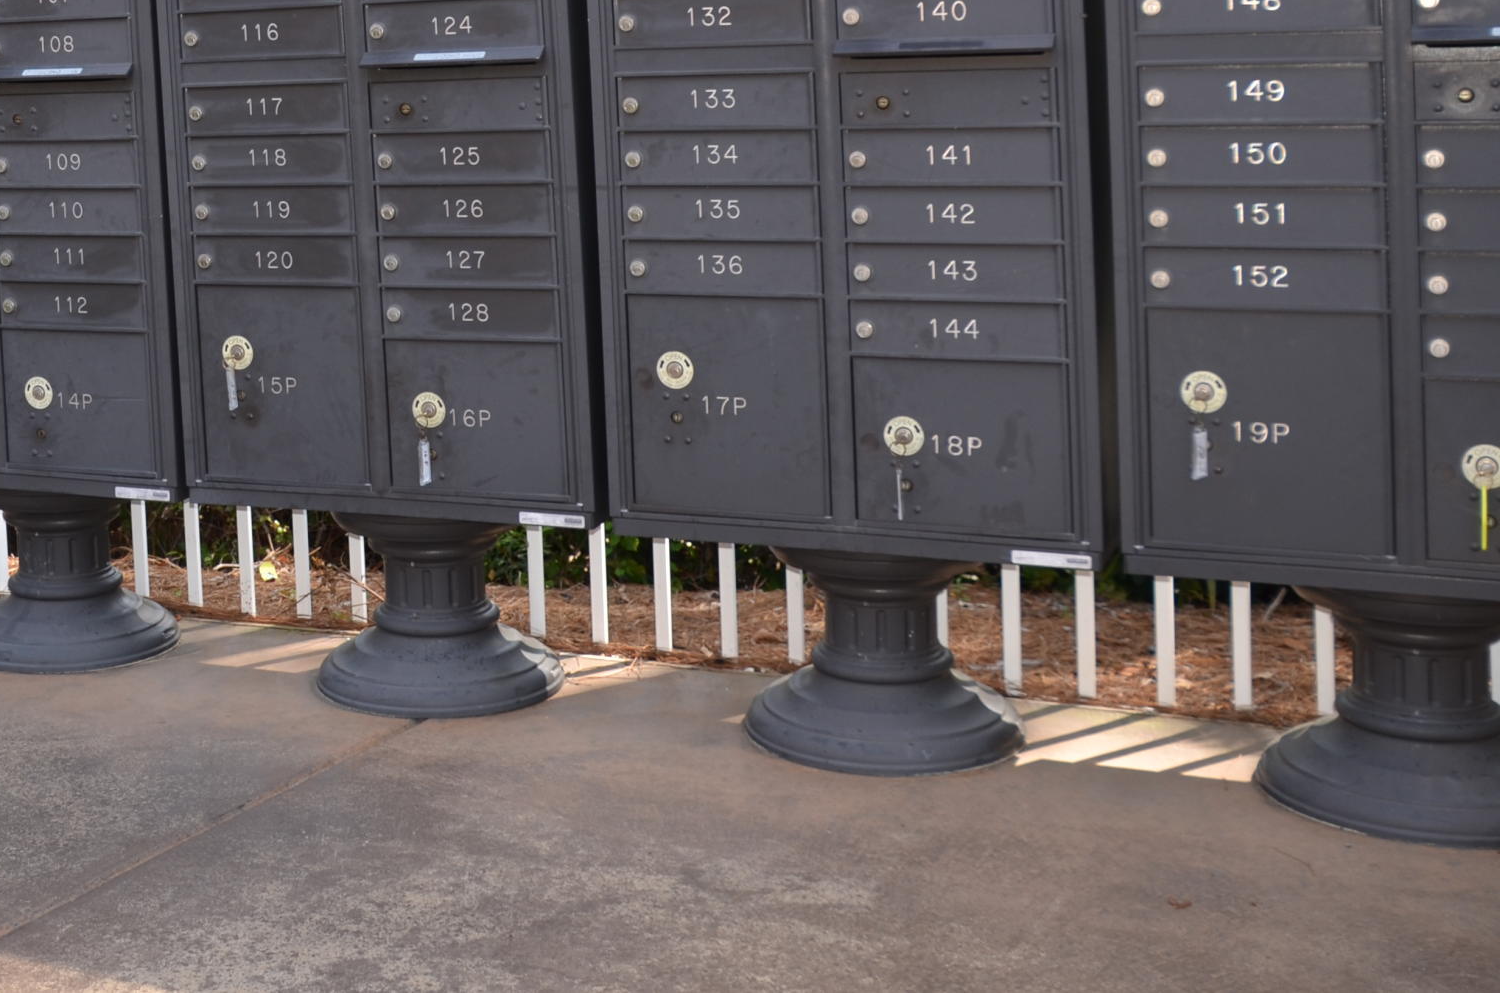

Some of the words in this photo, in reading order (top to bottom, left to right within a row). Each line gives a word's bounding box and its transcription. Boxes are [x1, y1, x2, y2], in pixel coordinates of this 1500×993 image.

[688, 6, 732, 26] 132
[917, 0, 966, 21] 140
[241, 23, 278, 41] 116
[432, 15, 472, 35] 124
[39, 35, 74, 53] 108
[691, 89, 735, 109] 133
[1228, 80, 1284, 101] 149
[246, 97, 282, 115] 117
[46, 153, 80, 170] 109
[249, 148, 286, 166] 118
[440, 147, 480, 165] 125
[693, 145, 738, 164] 134
[926, 145, 970, 165] 141
[1230, 142, 1286, 164] 150
[49, 202, 83, 219] 110
[253, 201, 290, 218] 119
[443, 199, 483, 218] 126
[696, 199, 740, 219] 135
[926, 203, 975, 224] 142
[1235, 203, 1284, 225] 151
[54, 248, 84, 265] 111
[255, 251, 293, 269] 120
[446, 250, 485, 269] 127
[698, 255, 742, 274] 136
[928, 260, 977, 281] 143
[1233, 265, 1288, 287] 152
[55, 296, 88, 314] 112
[449, 303, 489, 322] 128
[930, 318, 979, 339] 144
[258, 376, 296, 394] 15P
[58, 392, 93, 410] 14P
[702, 396, 746, 415] 17P
[450, 409, 491, 427] 16P
[1233, 421, 1289, 443] 19P
[932, 435, 982, 456] 18P
